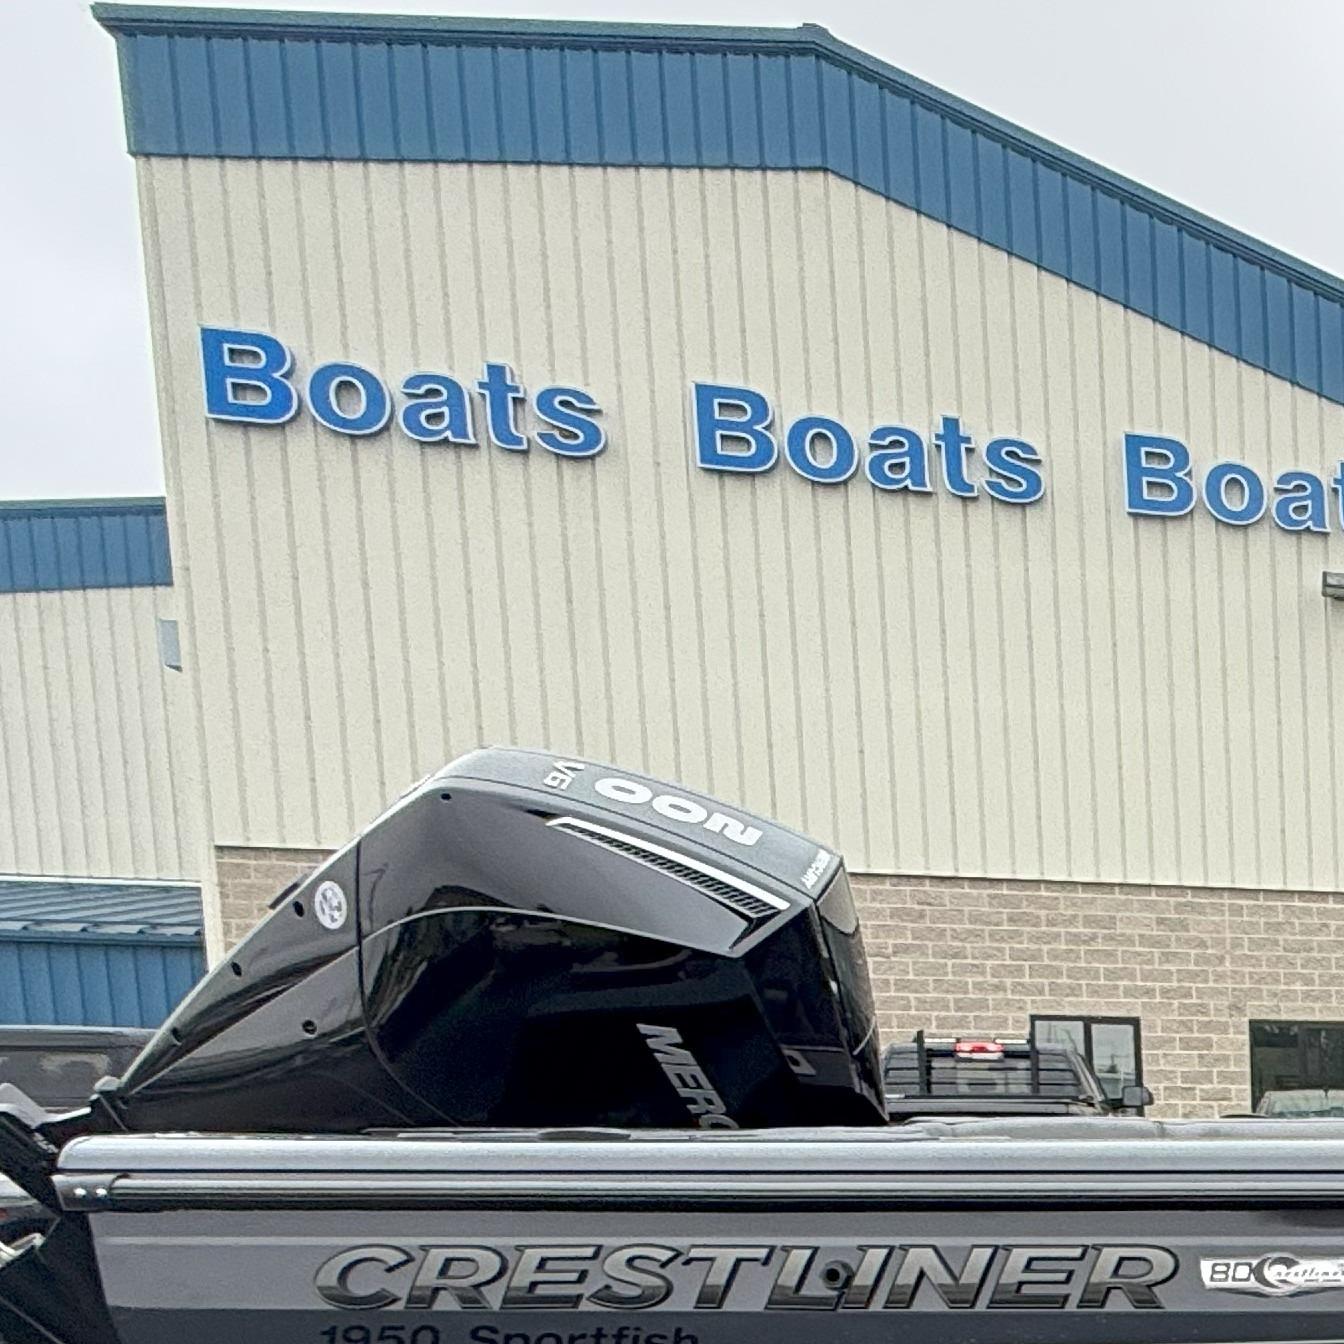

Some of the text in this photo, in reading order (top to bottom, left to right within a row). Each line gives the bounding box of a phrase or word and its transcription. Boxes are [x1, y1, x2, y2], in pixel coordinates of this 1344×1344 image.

[198, 324, 608, 457] Boats
[692, 382, 1045, 504] Boats
[543, 760, 585, 790] V6
[314, 1243, 1180, 1310] CRESTLINER
